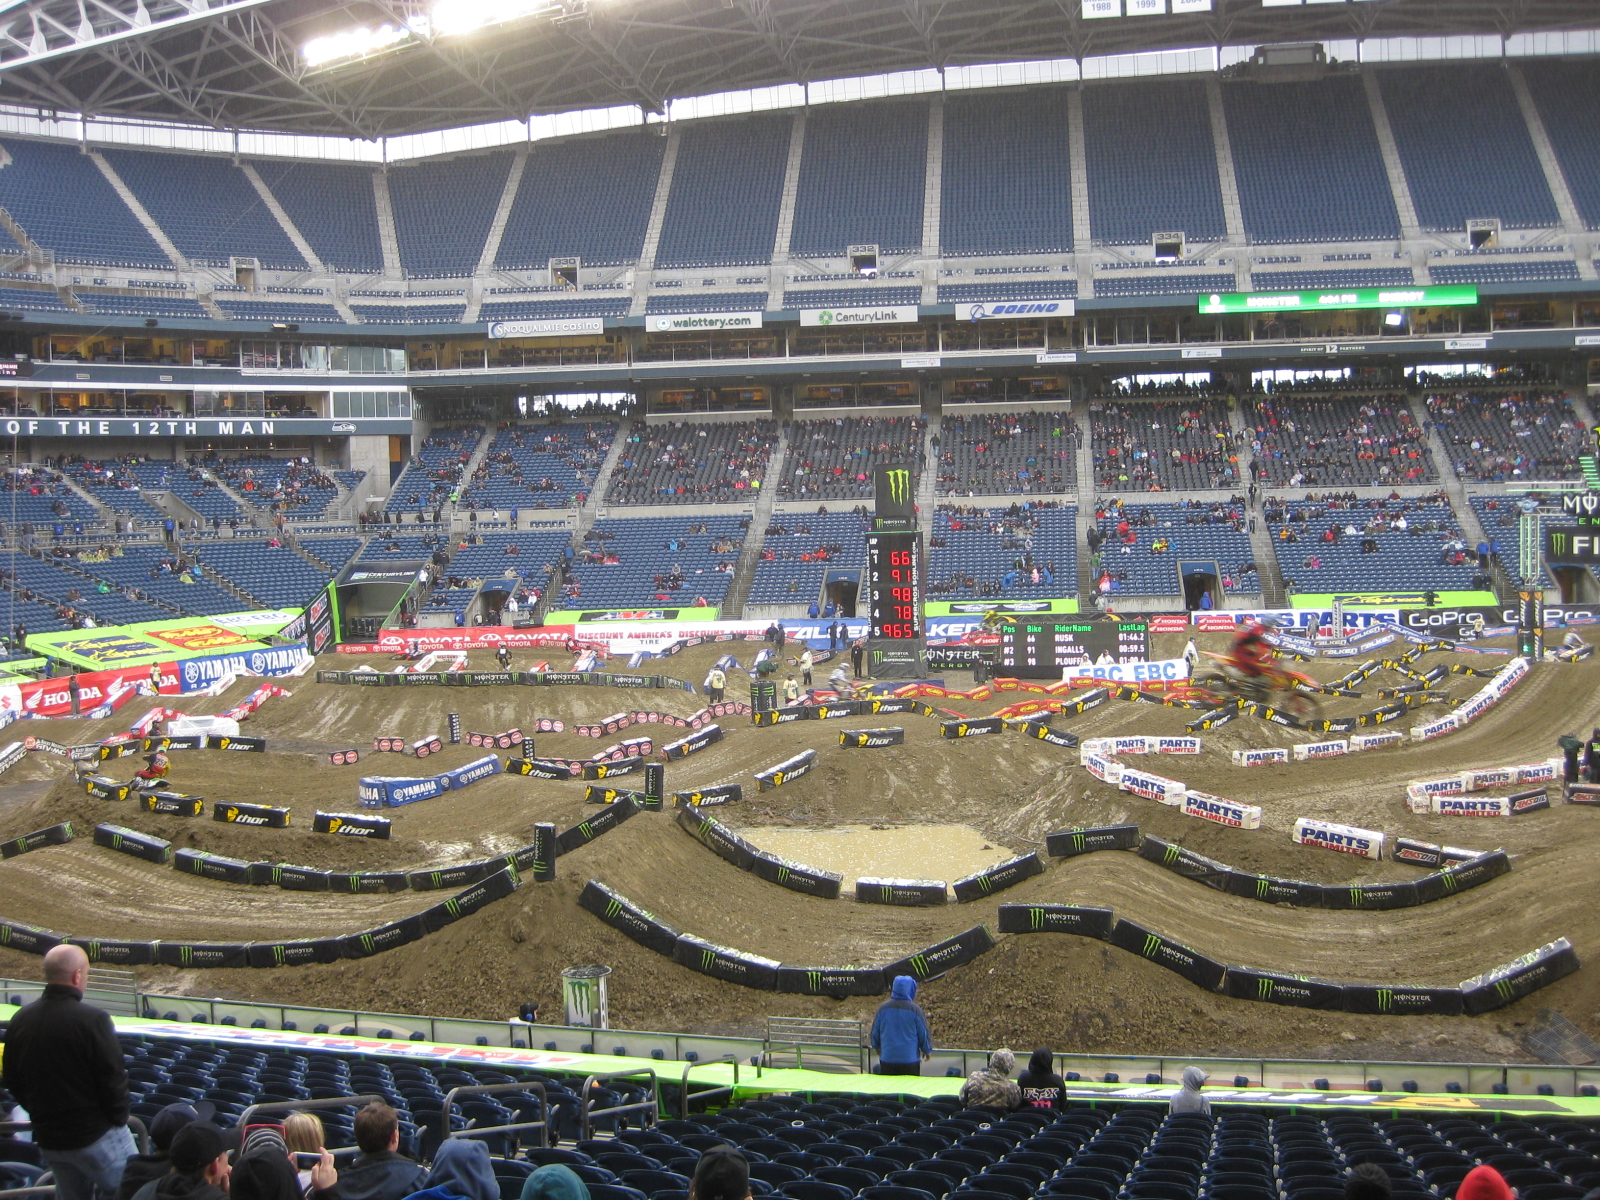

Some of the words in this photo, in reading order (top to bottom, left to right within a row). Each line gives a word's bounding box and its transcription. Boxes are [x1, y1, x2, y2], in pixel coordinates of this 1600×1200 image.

[1091, 2, 1112, 11] 1988
[1136, 0, 1156, 8] 1999
[1156, 232, 1181, 240] 334
[990, 303, 1060, 314] BOEING
[672, 316, 752, 328] walottery.com
[835, 310, 898, 323] CenturyLink
[562, 320, 600, 332] casino
[1325, 344, 1338, 354] 12
[7, 420, 39, 435] OF
[58, 421, 110, 435] THE
[132, 421, 198, 435] 12TH
[218, 421, 275, 435] MAN
[1572, 536, 1600, 554] FI
[872, 554, 878, 564] 1
[892, 551, 910, 566] 66
[872, 572, 878, 582] 2
[892, 570, 910, 582] 91
[873, 590, 880, 600] 3
[892, 588, 911, 602] 98
[874, 608, 880, 618] 4
[894, 606, 912, 620] 78
[874, 626, 880, 636] 5
[883, 624, 912, 638] 965
[1054, 624, 1092, 632] RiderName
[1118, 624, 1146, 632] LastLap
[1349, 626, 1381, 642] FALKEN
[578, 632, 624, 640] DISCOUNT
[1004, 634, 1014, 642] #1
[1026, 634, 1036, 642] 66
[1054, 634, 1074, 642] RUSK
[1118, 633, 1145, 641] 01:46.2
[1360, 634, 1395, 650] FALKEN
[926, 648, 980, 661] ONSTER
[1004, 646, 1014, 655] #2
[1026, 646, 1036, 654] 91
[1055, 646, 1084, 654] INGALLS
[1118, 644, 1145, 653] 00:59.5
[1282, 642, 1317, 655] FALKEN
[1322, 647, 1358, 656] FALKEN
[1004, 658, 1014, 666] #3
[1026, 658, 1036, 666] 98
[1055, 657, 1084, 666] PLOUFF
[1078, 666, 1123, 681] EBC
[1134, 662, 1177, 682] EBC
[1496, 666, 1526, 694] PARTS
[880, 704, 903, 712] thor
[1083, 697, 1103, 711] thor
[1465, 694, 1494, 720] PARTS
[778, 712, 799, 722] thor
[826, 709, 850, 717] thor
[1270, 712, 1292, 726] thor
[1212, 714, 1231, 729] thor
[1329, 722, 1349, 732] thor
[1423, 718, 1456, 736] PARTS
[966, 725, 992, 736] thor
[688, 737, 710, 751] thor
[866, 736, 894, 746] thor
[1044, 732, 1070, 746] thor
[1115, 738, 1146, 748] PARTS
[1159, 739, 1196, 748] PARTS
[1364, 734, 1400, 747] PARTS
[168, 741, 192, 750] thor
[228, 742, 254, 751] thor
[1308, 743, 1344, 754] PARTS
[121, 748, 136, 757] thor
[1308, 750, 1344, 759] UNLIMITED
[1088, 755, 1105, 772] PARTS
[467, 764, 494, 782] YAMAHA
[528, 768, 557, 780] thor
[605, 764, 632, 777] thor
[782, 764, 809, 782] thor
[1517, 766, 1554, 779] PARTS
[1473, 771, 1510, 784] PARTS
[402, 780, 437, 797] YAMAHA
[1121, 774, 1166, 794] PARTS
[1424, 780, 1462, 795] PARTS
[92, 786, 109, 798] thor
[700, 794, 730, 806] thor
[1440, 800, 1501, 810] PARTS
[1513, 794, 1547, 810] AMSOIL
[1186, 796, 1243, 820] PARTS
[235, 812, 269, 824] thor
[1185, 806, 1242, 827] UNLIMITED
[338, 823, 376, 836] thor
[1085, 834, 1115, 842] MONSTER
[1301, 826, 1370, 850] PARTS
[1300, 838, 1369, 857] UNLIMITED
[1399, 849, 1437, 863] AMSOIL
[1268, 884, 1298, 894] MONSTER
[1364, 890, 1393, 898] MONSTER
[1046, 913, 1081, 922] MONSTER
[101, 946, 131, 954] MONSTER
[193, 950, 224, 958] MONSTER
[926, 943, 962, 964] MONSTER
[1159, 944, 1194, 964] MONSTER
[822, 976, 856, 984] MONSTER
[1511, 966, 1547, 986] MONSTER
[1274, 985, 1311, 996] MONSTER
[1393, 994, 1431, 1002] MONSTER
